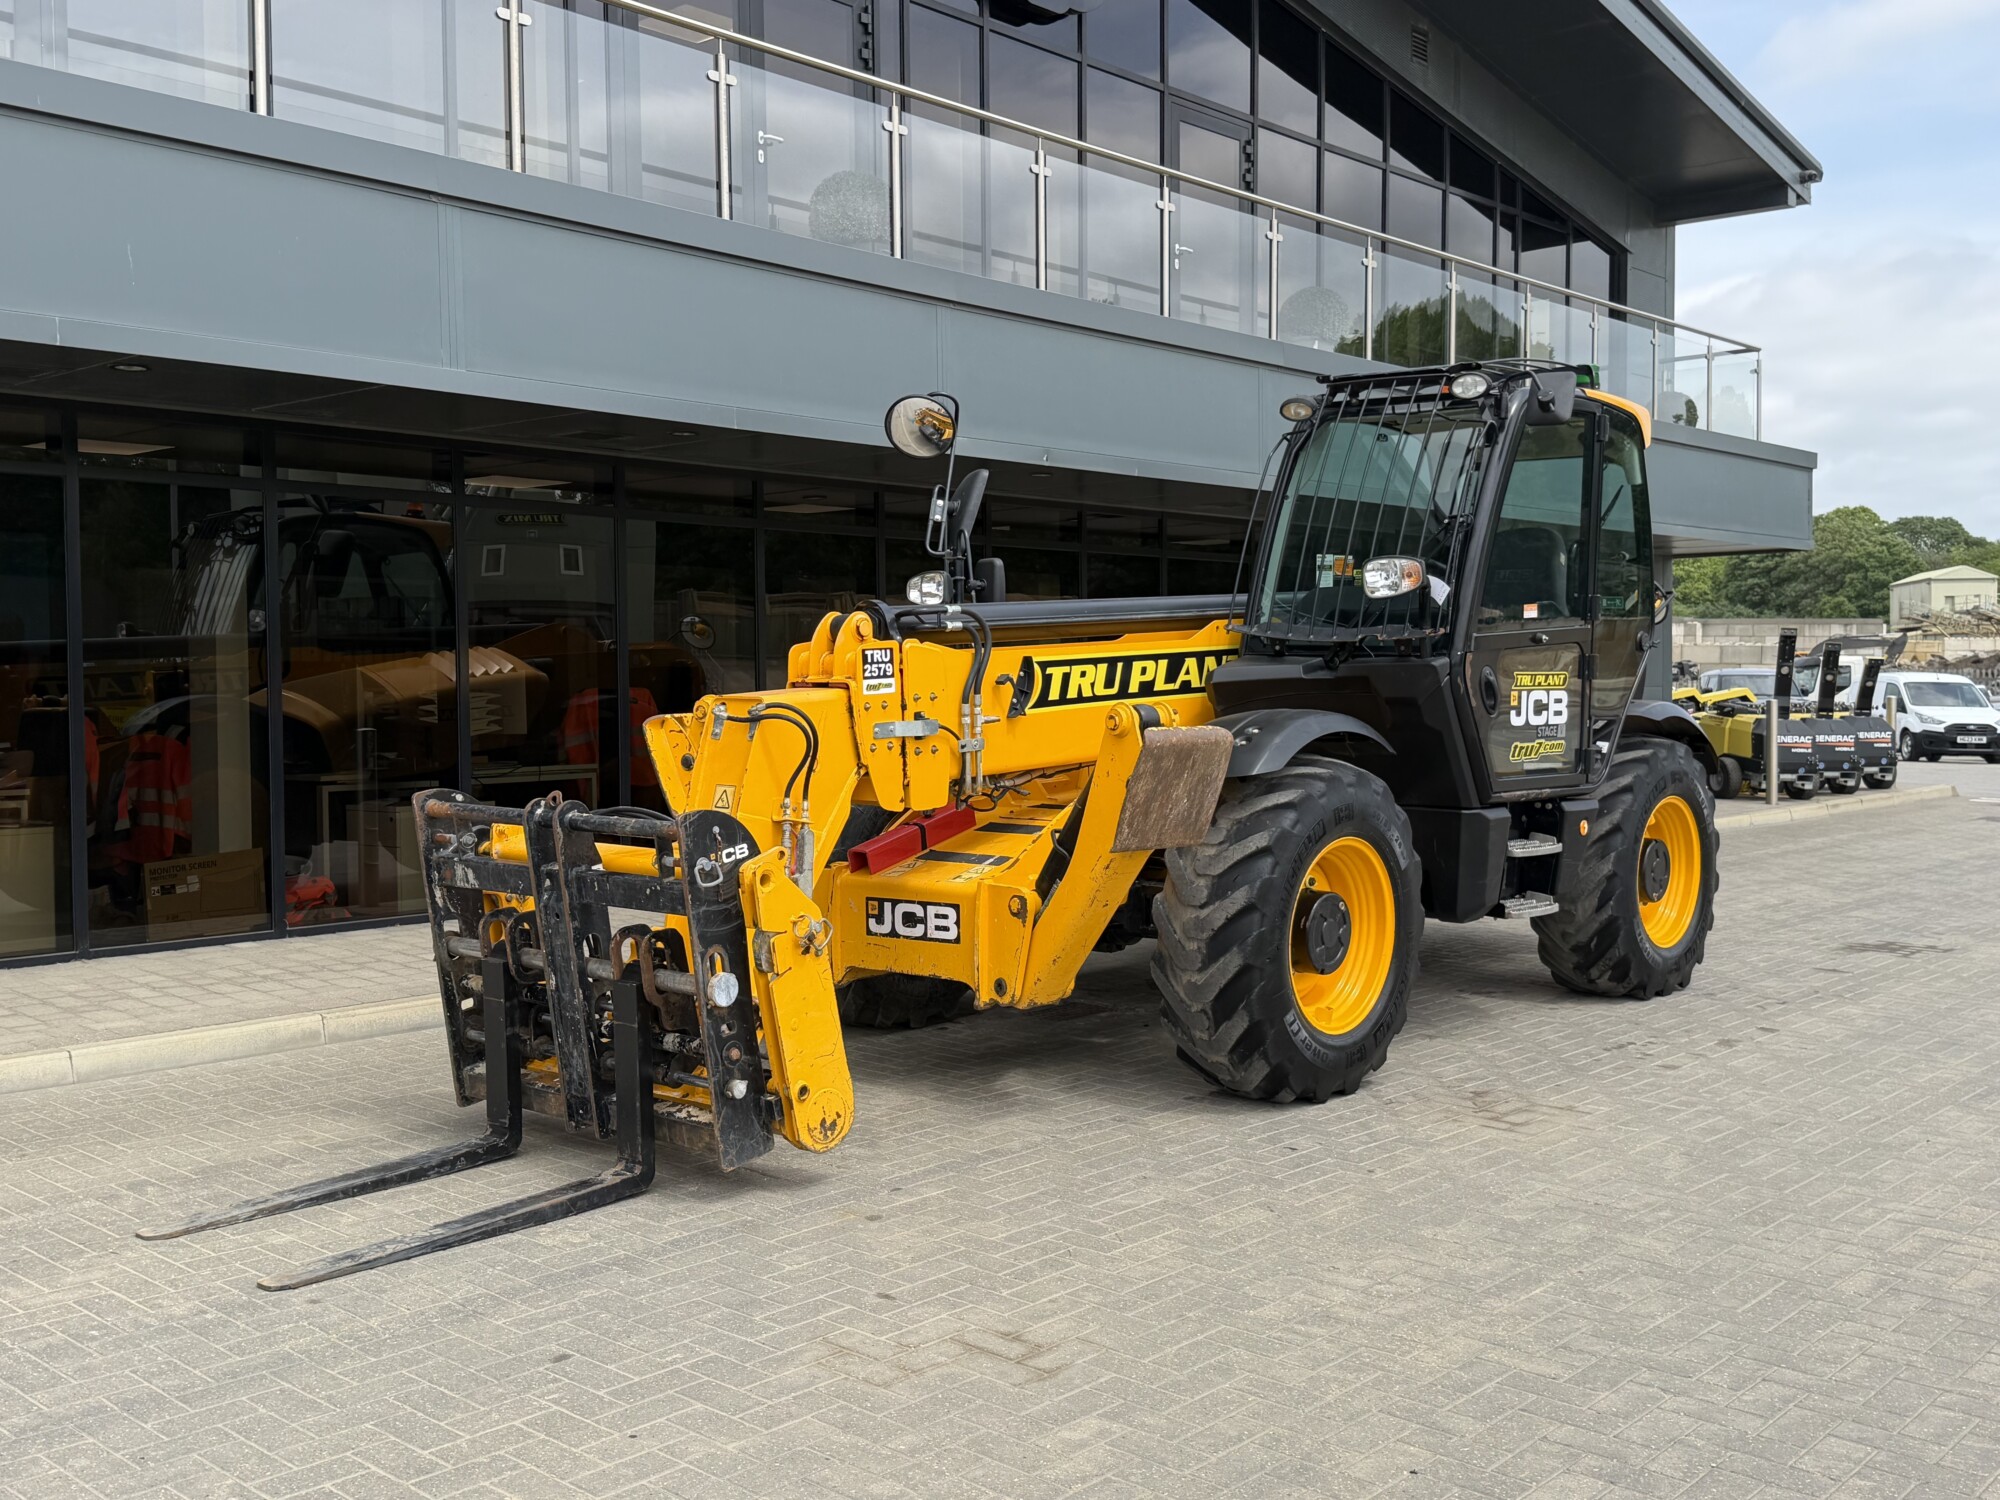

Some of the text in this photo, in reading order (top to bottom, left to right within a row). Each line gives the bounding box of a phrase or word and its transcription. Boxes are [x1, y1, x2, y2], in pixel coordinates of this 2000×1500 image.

[864, 649, 890, 662] TRU
[863, 663, 893, 677] 2579
[1045, 662, 1123, 700] TRU
[1517, 675, 1565, 686] TRU PLANT
[1510, 690, 1568, 726] JCB
[1537, 726, 1557, 737] STAGE
[1510, 740, 1565, 761] tru7.com
[718, 843, 749, 864] CB
[149, 860, 217, 876] MONITOR SCREEN
[868, 901, 958, 940] JCB
